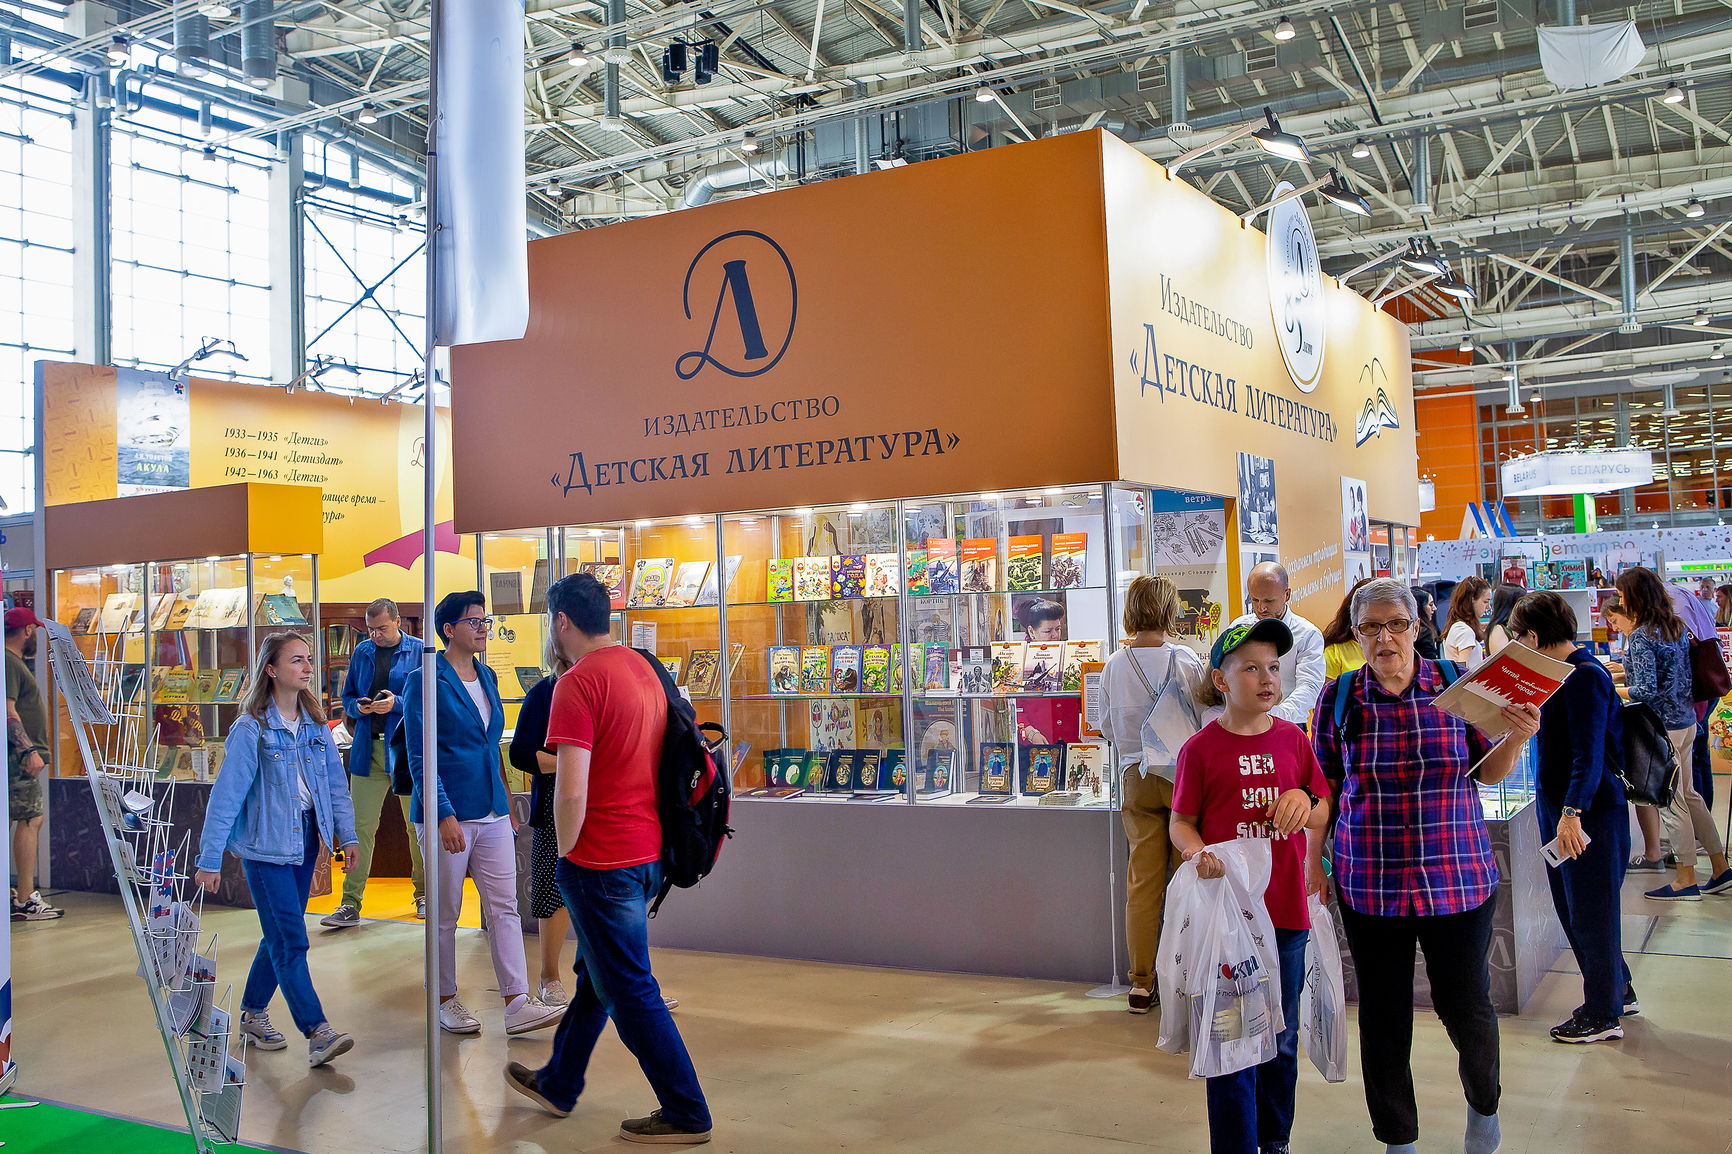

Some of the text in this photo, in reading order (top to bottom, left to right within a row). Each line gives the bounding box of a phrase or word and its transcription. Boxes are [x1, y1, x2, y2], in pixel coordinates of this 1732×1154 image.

[642, 395, 840, 437] ИЗДАТЕЛЬСТВО
[283, 431, 329, 447] «Детгиз»
[283, 450, 344, 466] «Детиздат»
[136, 462, 170, 473] АКУЛА
[1570, 464, 1631, 476] БЕЛАРУСЬ
[283, 468, 329, 483] «Детгиз»
[1513, 469, 1537, 484] BELARUS
[321, 493, 349, 504] оящее
[350, 493, 377, 506] время
[1184, 495, 1212, 505] ветра
[1501, 665, 1520, 680] Читай,
[1514, 683, 1537, 696] город!
[1242, 786, 1279, 810] YOU
